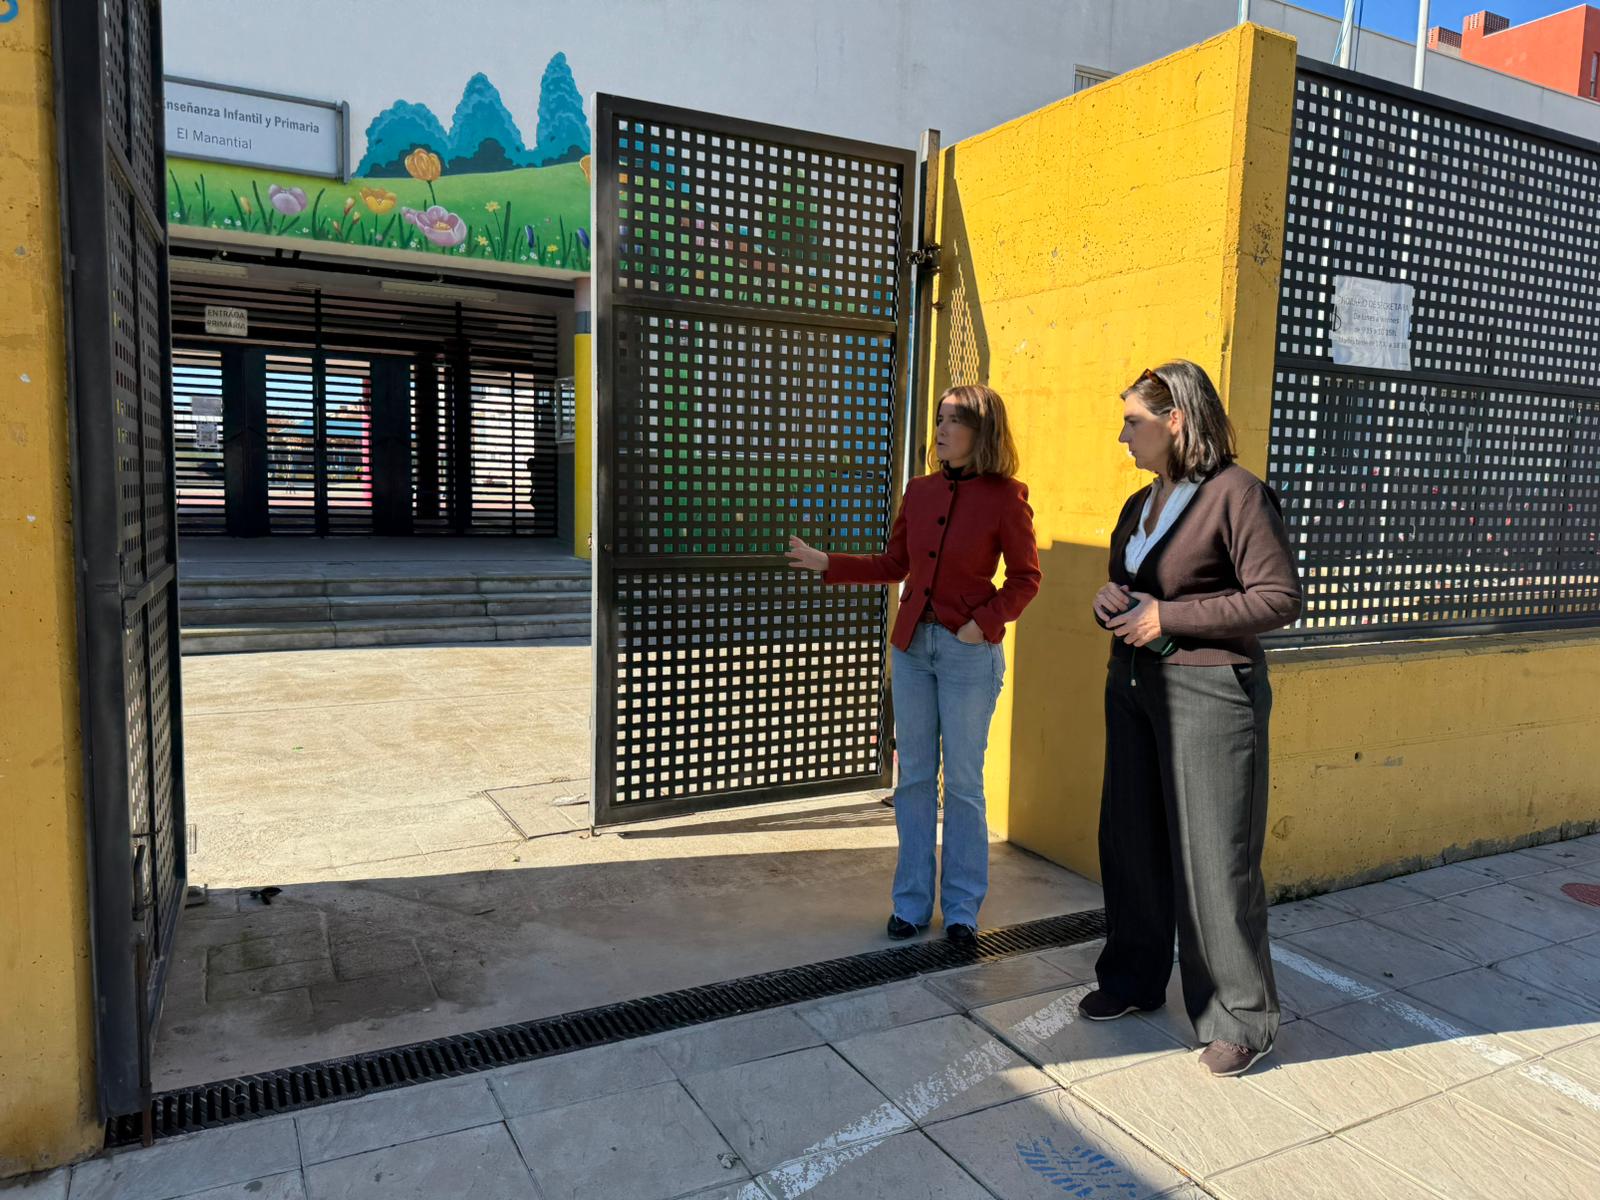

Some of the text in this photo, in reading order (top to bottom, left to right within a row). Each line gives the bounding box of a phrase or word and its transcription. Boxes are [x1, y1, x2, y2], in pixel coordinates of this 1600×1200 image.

[164, 100, 320, 134] nseñanza Infantil y Primaria
[176, 127, 253, 150] El Manantial
[207, 309, 245, 320] ENTRADA
[207, 319, 246, 330] PRIMARIA
